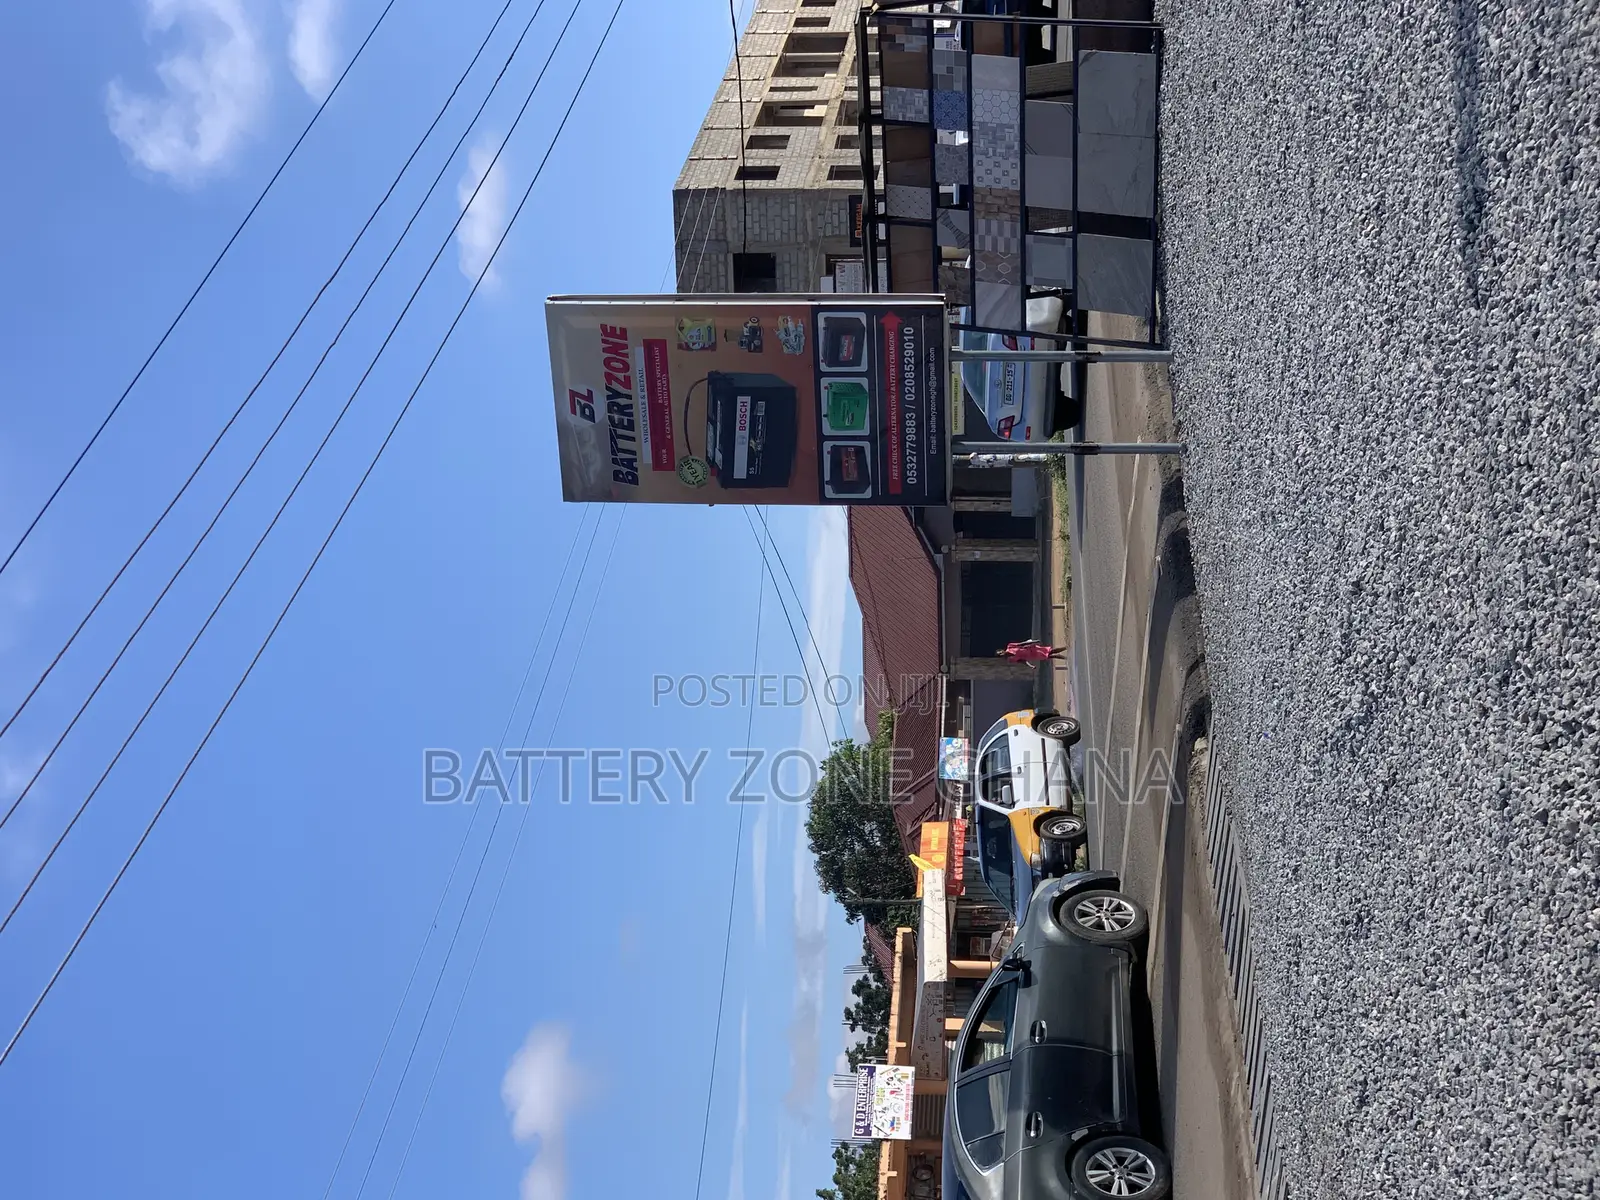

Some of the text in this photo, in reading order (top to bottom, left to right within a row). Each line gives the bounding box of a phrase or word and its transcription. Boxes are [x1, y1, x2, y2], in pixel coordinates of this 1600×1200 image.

[888, 331, 896, 363] CHARGING
[903, 326, 915, 401] 0208529010
[600, 323, 639, 486] BATTERYZONE
[738, 401, 748, 432] BOSCH
[890, 396, 898, 436] ALTERNATOR
[891, 435, 898, 444] OF
[906, 412, 917, 484] 0532779883
[684, 460, 700, 480] YEAR
[857, 1067, 868, 1111] ENTERPRISE
